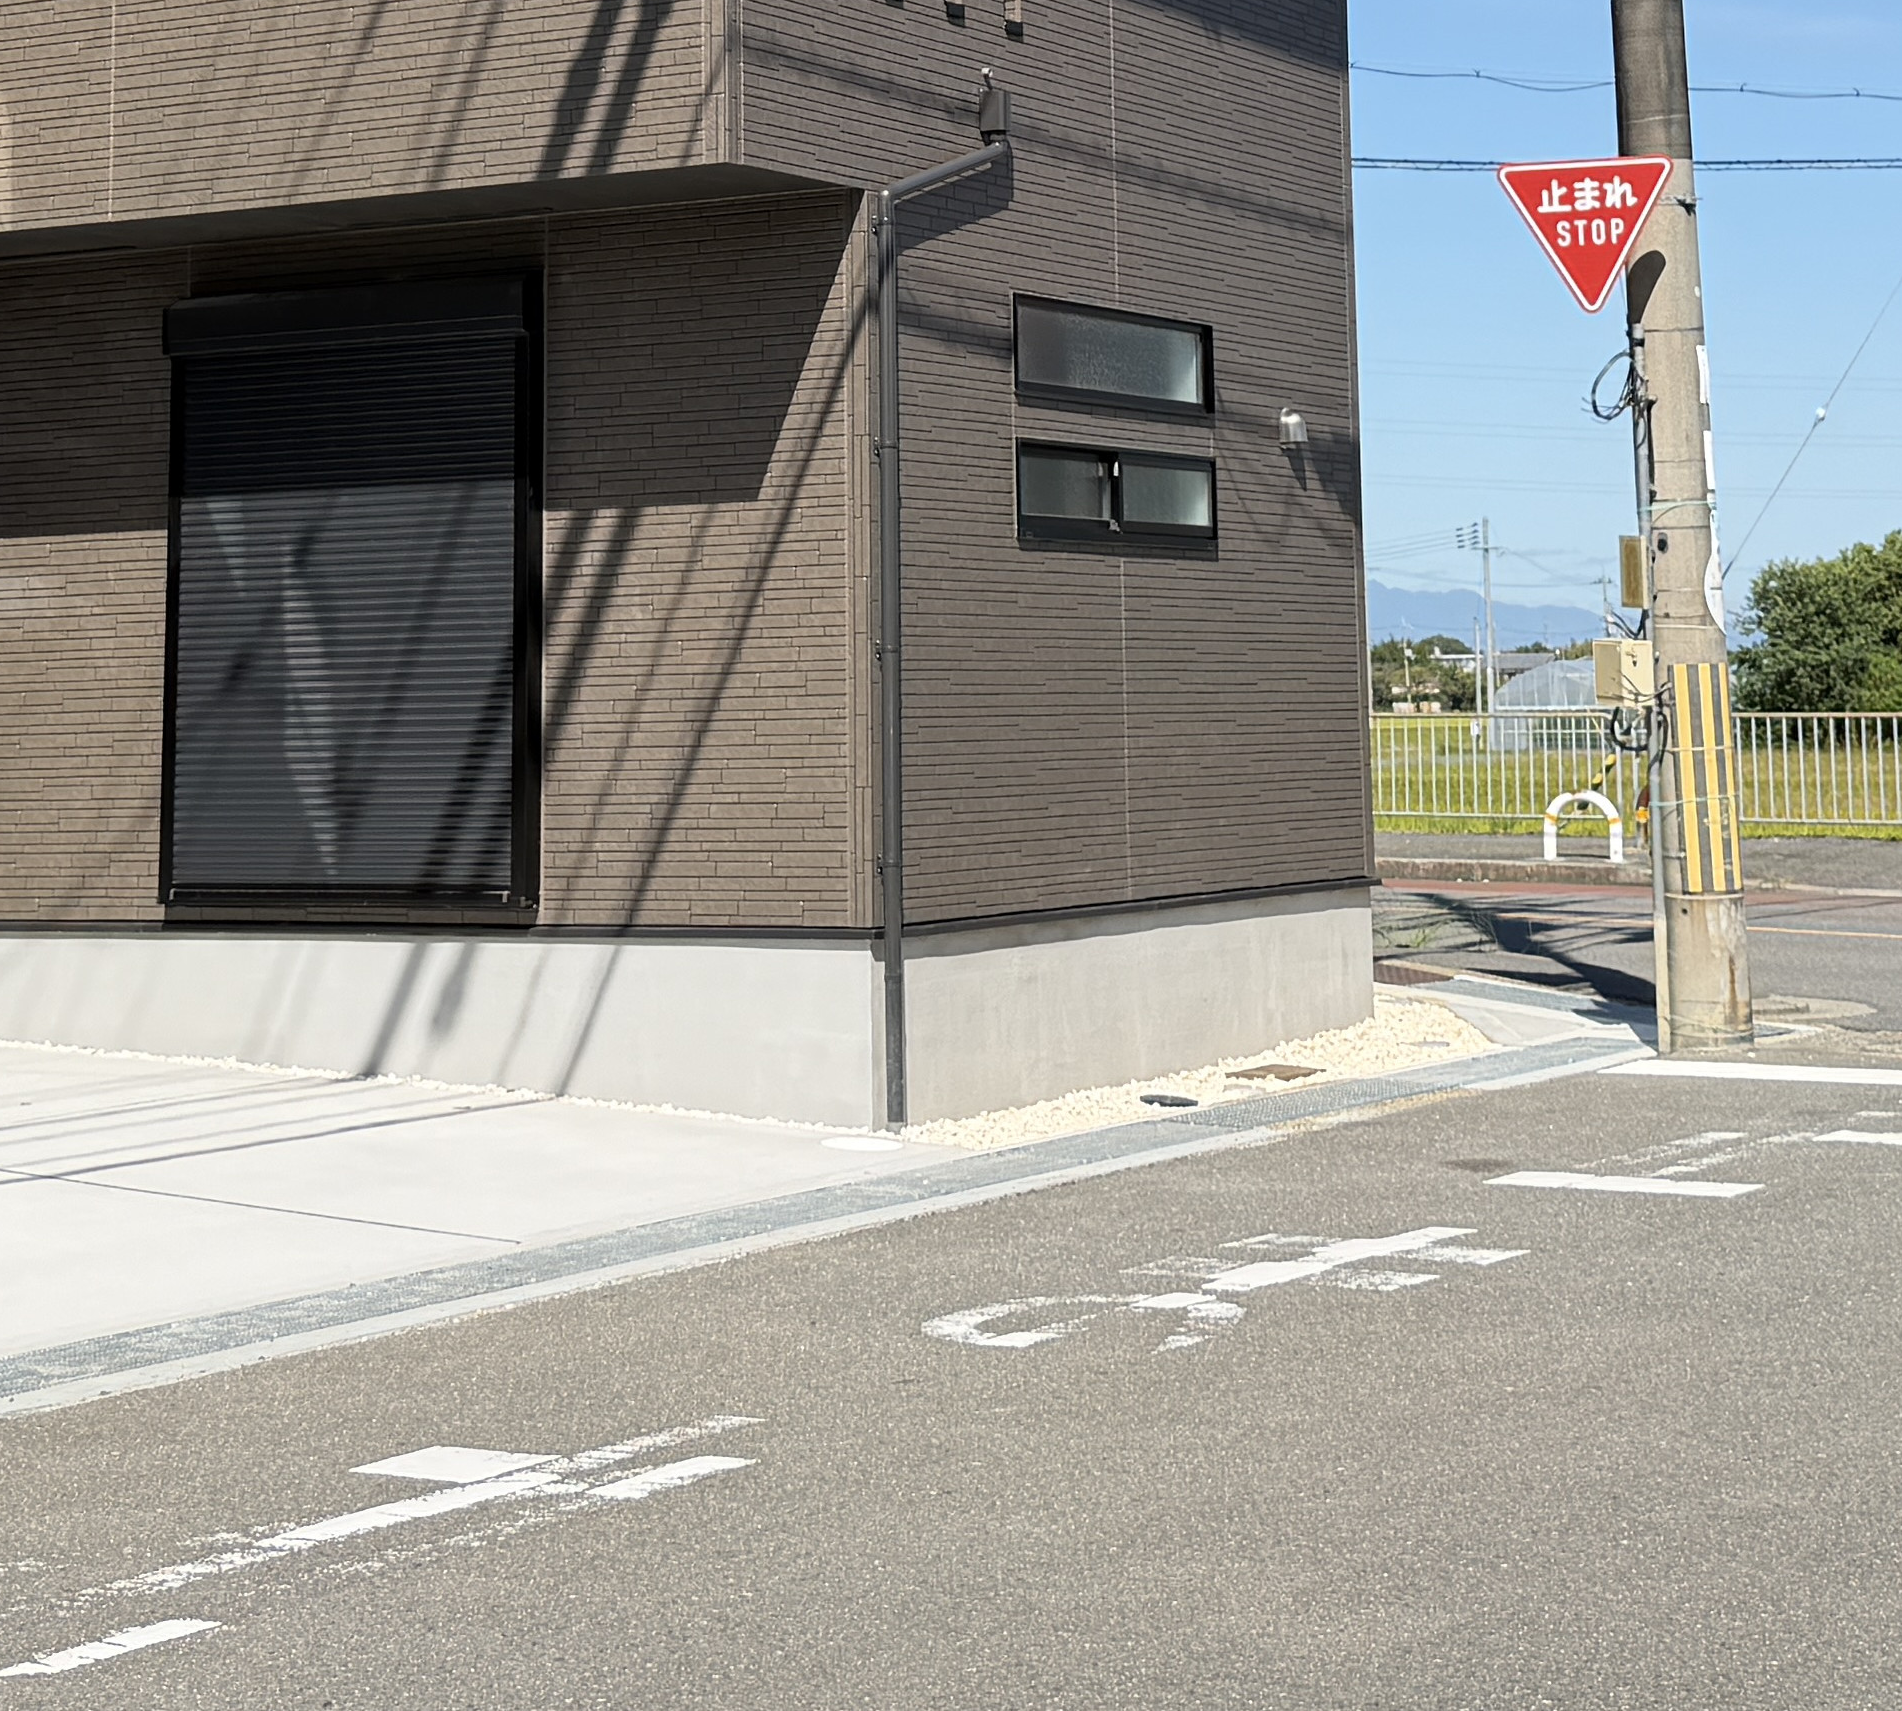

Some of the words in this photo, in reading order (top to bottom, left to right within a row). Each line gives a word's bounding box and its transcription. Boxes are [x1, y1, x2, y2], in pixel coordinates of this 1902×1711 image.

[1537, 175, 1638, 213] 止まれ
[1556, 218, 1625, 247] STOP
